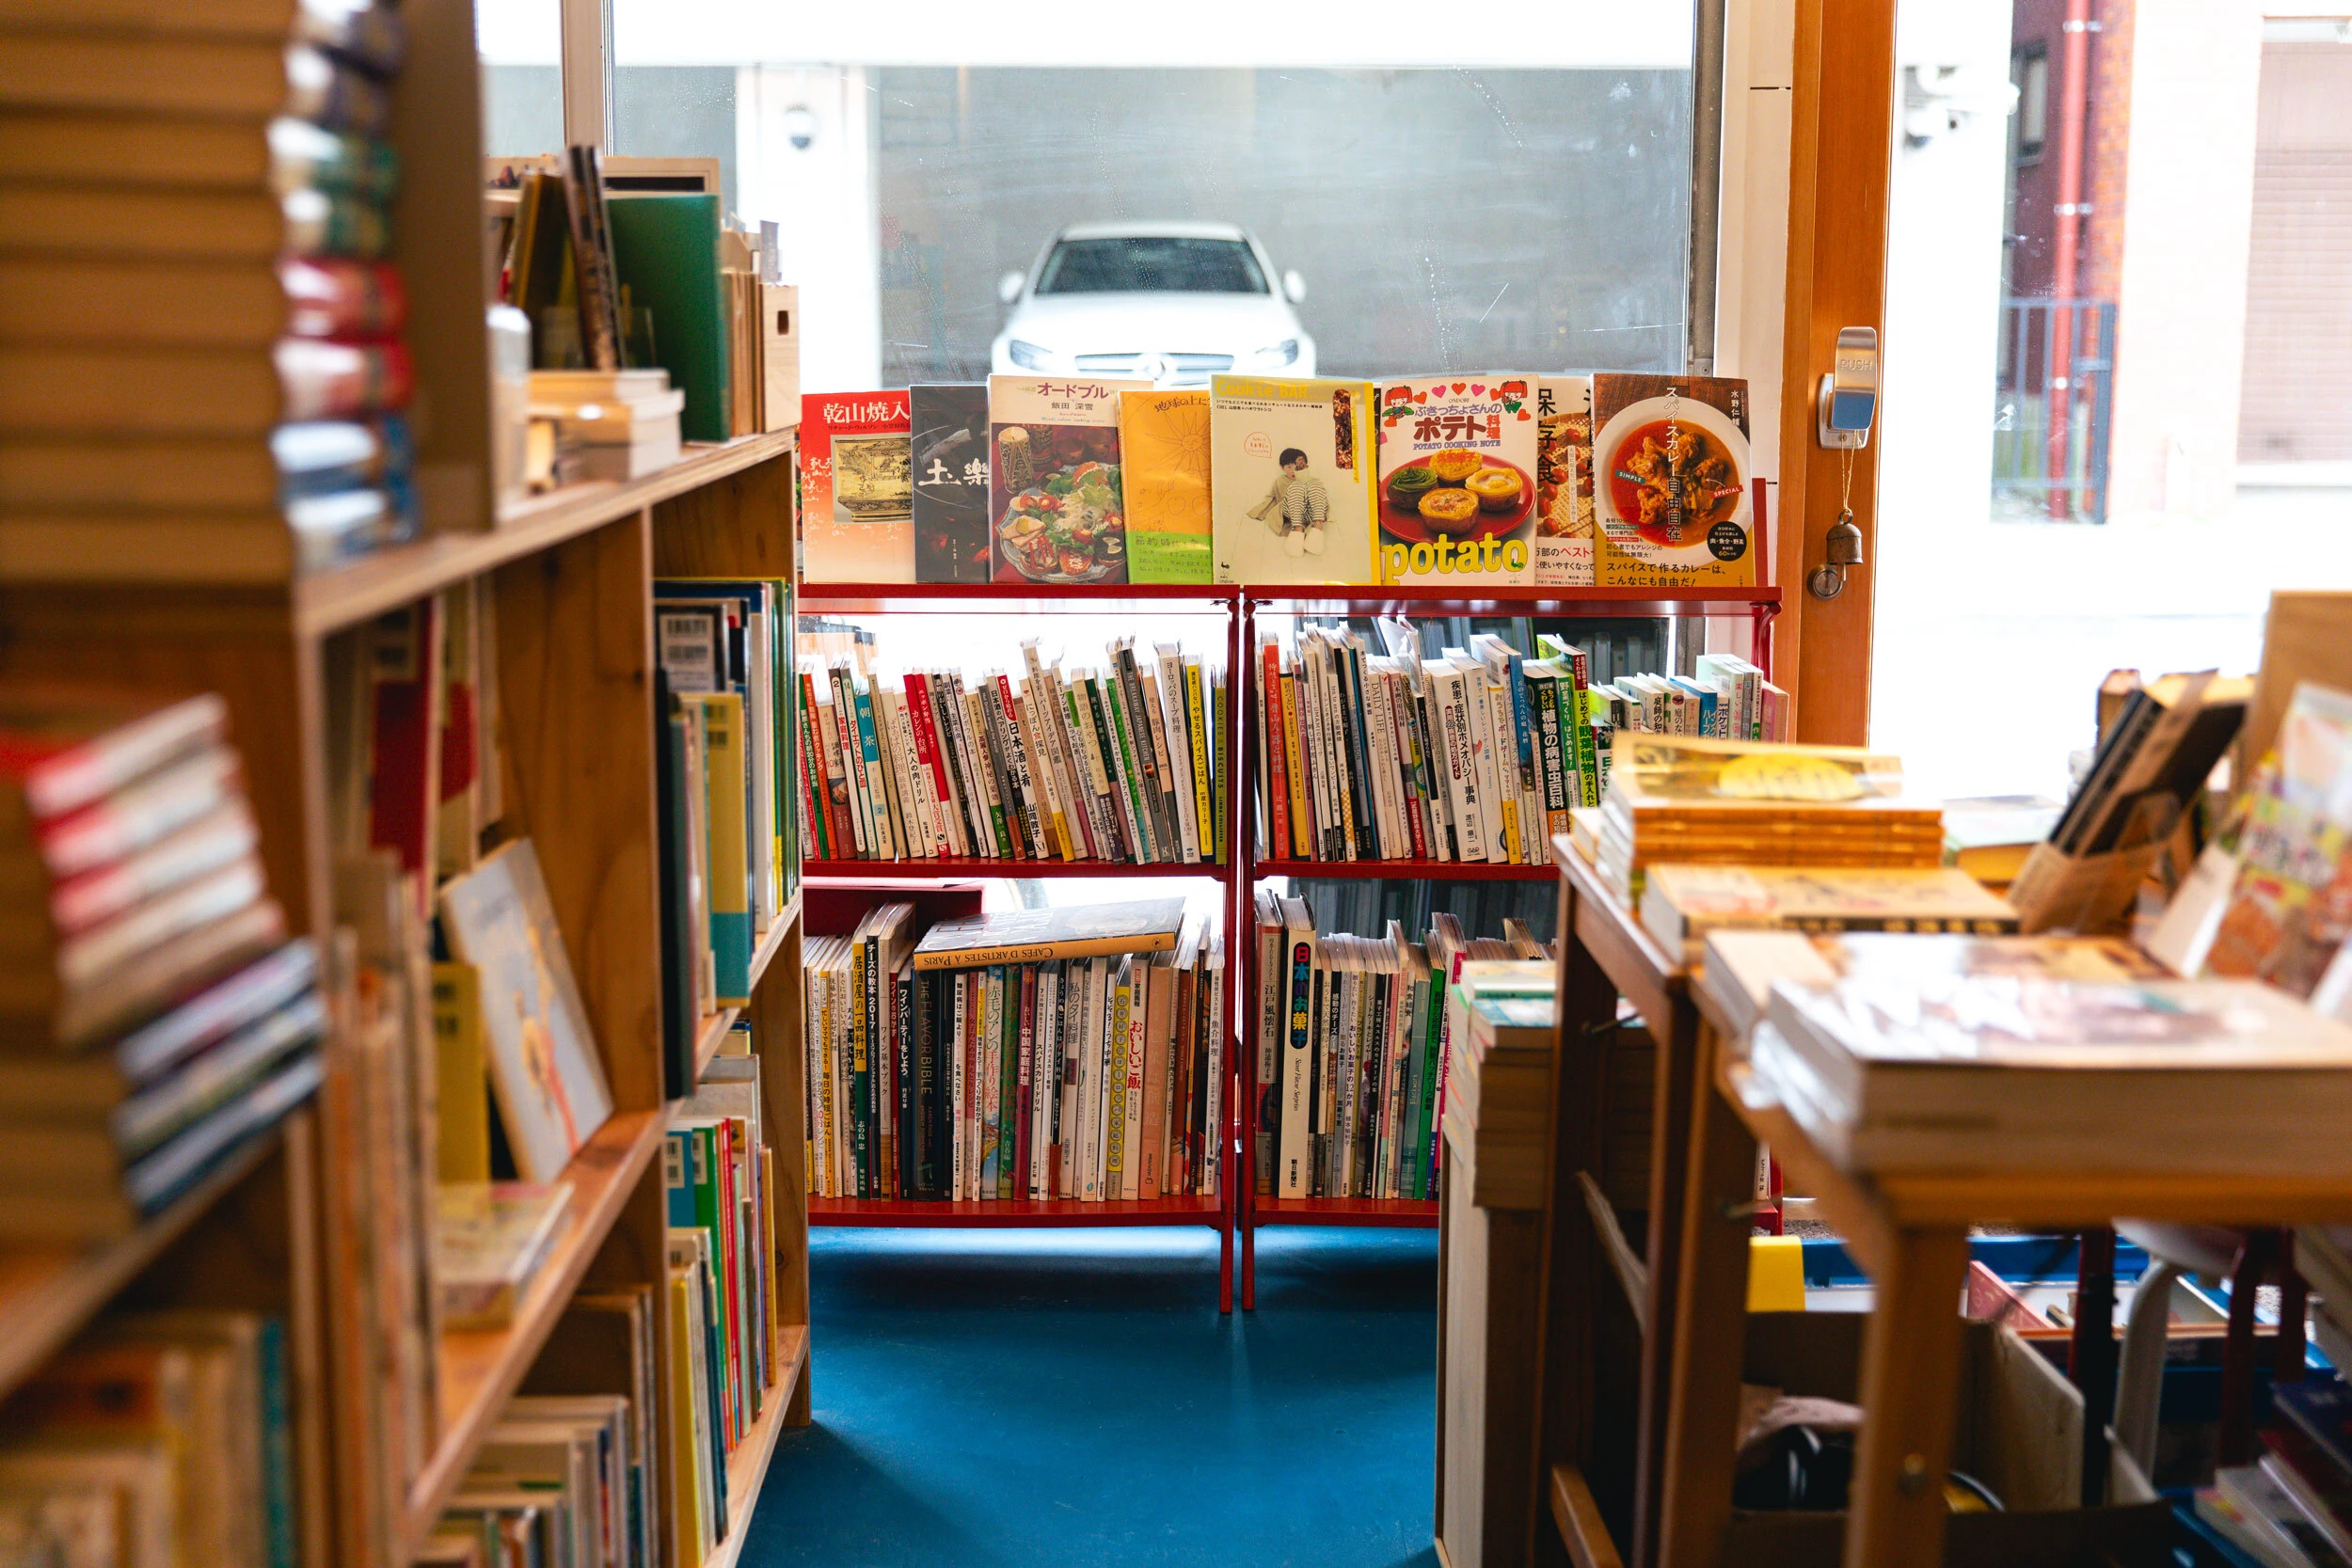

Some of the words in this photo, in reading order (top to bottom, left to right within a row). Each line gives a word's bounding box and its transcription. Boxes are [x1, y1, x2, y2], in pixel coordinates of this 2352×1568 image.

[1038, 383, 1109, 400] オードブル
[1216, 380, 1274, 398] Cookie
[1841, 358, 1871, 371] PUSH
[1051, 402, 1070, 410] 飯田
[1413, 416, 1486, 441] ポテト
[1486, 414, 1501, 439] 料理
[1414, 402, 1502, 418] ぶきっちょさんの
[1413, 442, 1442, 451] POTATO
[1444, 441, 1477, 450] COOKING
[1618, 470, 1643, 483] SIMPLE
[1712, 487, 1740, 498] SPECIAL
[1381, 531, 1528, 586] potato
[1606, 562, 1726, 574] スパイスで作るカレーは、
[1607, 577, 1695, 587] こんなにも自由だ！
[1057, 681, 1072, 720] オーブン料理
[1129, 683, 1140, 714] BREAKAWAY
[1136, 715, 1146, 740] JAPANESE
[1167, 662, 1182, 733] ヨーロッパのスープ料理
[1372, 683, 1382, 710] DAILY
[839, 717, 850, 750] 家庭料理
[912, 710, 927, 753] カレンの台所
[1025, 703, 1047, 757] にっぽん食探見
[1040, 699, 1062, 764] パーツアイデア図鑑
[1192, 706, 1206, 785] やせるスパイスごはん
[1375, 714, 1385, 734] LIFE
[1451, 680, 1476, 805] 疾患・症状別ホメオパシー事典
[1494, 693, 1509, 766] おうちでボードゲーム
[1578, 691, 1595, 808] はじめての観葉植物の手入れと
[850, 720, 867, 788] ダイエットのひと皿
[907, 747, 926, 804] 大人の肉ドリル
[1009, 721, 1031, 787] 日本酒と肴
[1541, 709, 1565, 809] 植物の病害虫百科
[867, 944, 877, 995] チーズの教本
[924, 957, 951, 966] PARIS
[964, 949, 1019, 962] D'ARTISTES
[1020, 947, 1054, 959] CAFÉS
[853, 955, 866, 1061] 居酒屋の一品料理
[921, 980, 930, 997] THE
[1067, 983, 1080, 1044] 私のタイ料理
[1263, 985, 1275, 1037] 江戸風懐石
[1293, 946, 1310, 1047] 日本のお菓子
[899, 989, 909, 1078] ワインパーティーをしよう。
[921, 999, 931, 1054] FLAVOR
[986, 986, 1001, 1112] 赤毛のアンの手作り絵本
[1211, 1021, 1219, 1056] 魚介料理
[880, 1027, 889, 1096] ワイン基本ブック
[921, 1056, 932, 1095] BIBLE
[1020, 1028, 1031, 1086] 中国家庭料理
[1035, 1044, 1043, 1112] スパイスカレードリル
[1109, 995, 1128, 1167] 石井好子のヨーロッパ家庭料理
[1127, 1021, 1143, 1090] おいしいご飯
[1345, 1025, 1357, 1108] おいしいお菓子の12か月
